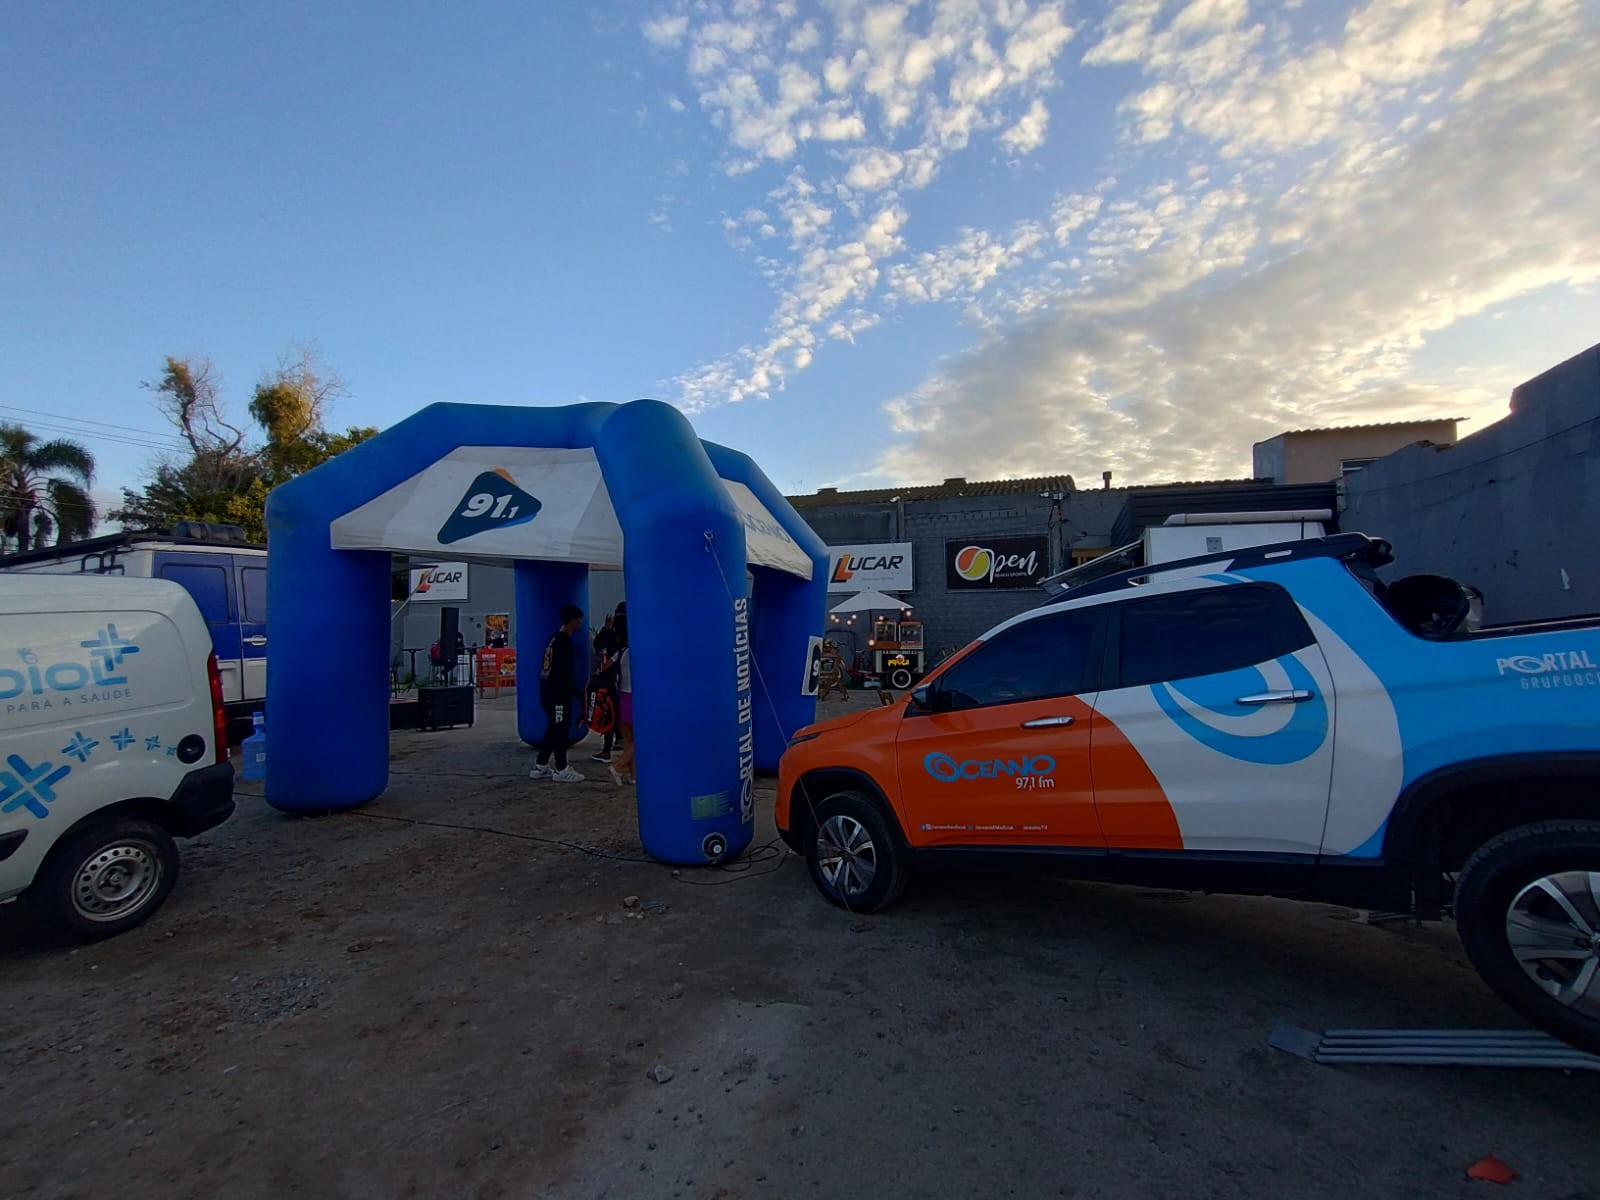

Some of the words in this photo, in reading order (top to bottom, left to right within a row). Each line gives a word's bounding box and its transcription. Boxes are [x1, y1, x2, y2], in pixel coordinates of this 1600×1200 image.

[461, 493, 520, 519] 91.1
[416, 570, 463, 593] LUCAR
[830, 553, 904, 584] LUCAR
[733, 598, 750, 692] NOTÍCIAS
[1496, 649, 1597, 676] PORTAL
[7, 699, 53, 715] PARA
[63, 696, 72, 706] A
[80, 688, 133, 704] SAÚDE
[587, 691, 597, 723] HEAD
[738, 695, 751, 724] DE
[923, 752, 1056, 783] OCEANO
[1015, 777, 1036, 791] 97,1
[1038, 775, 1055, 789] fm
